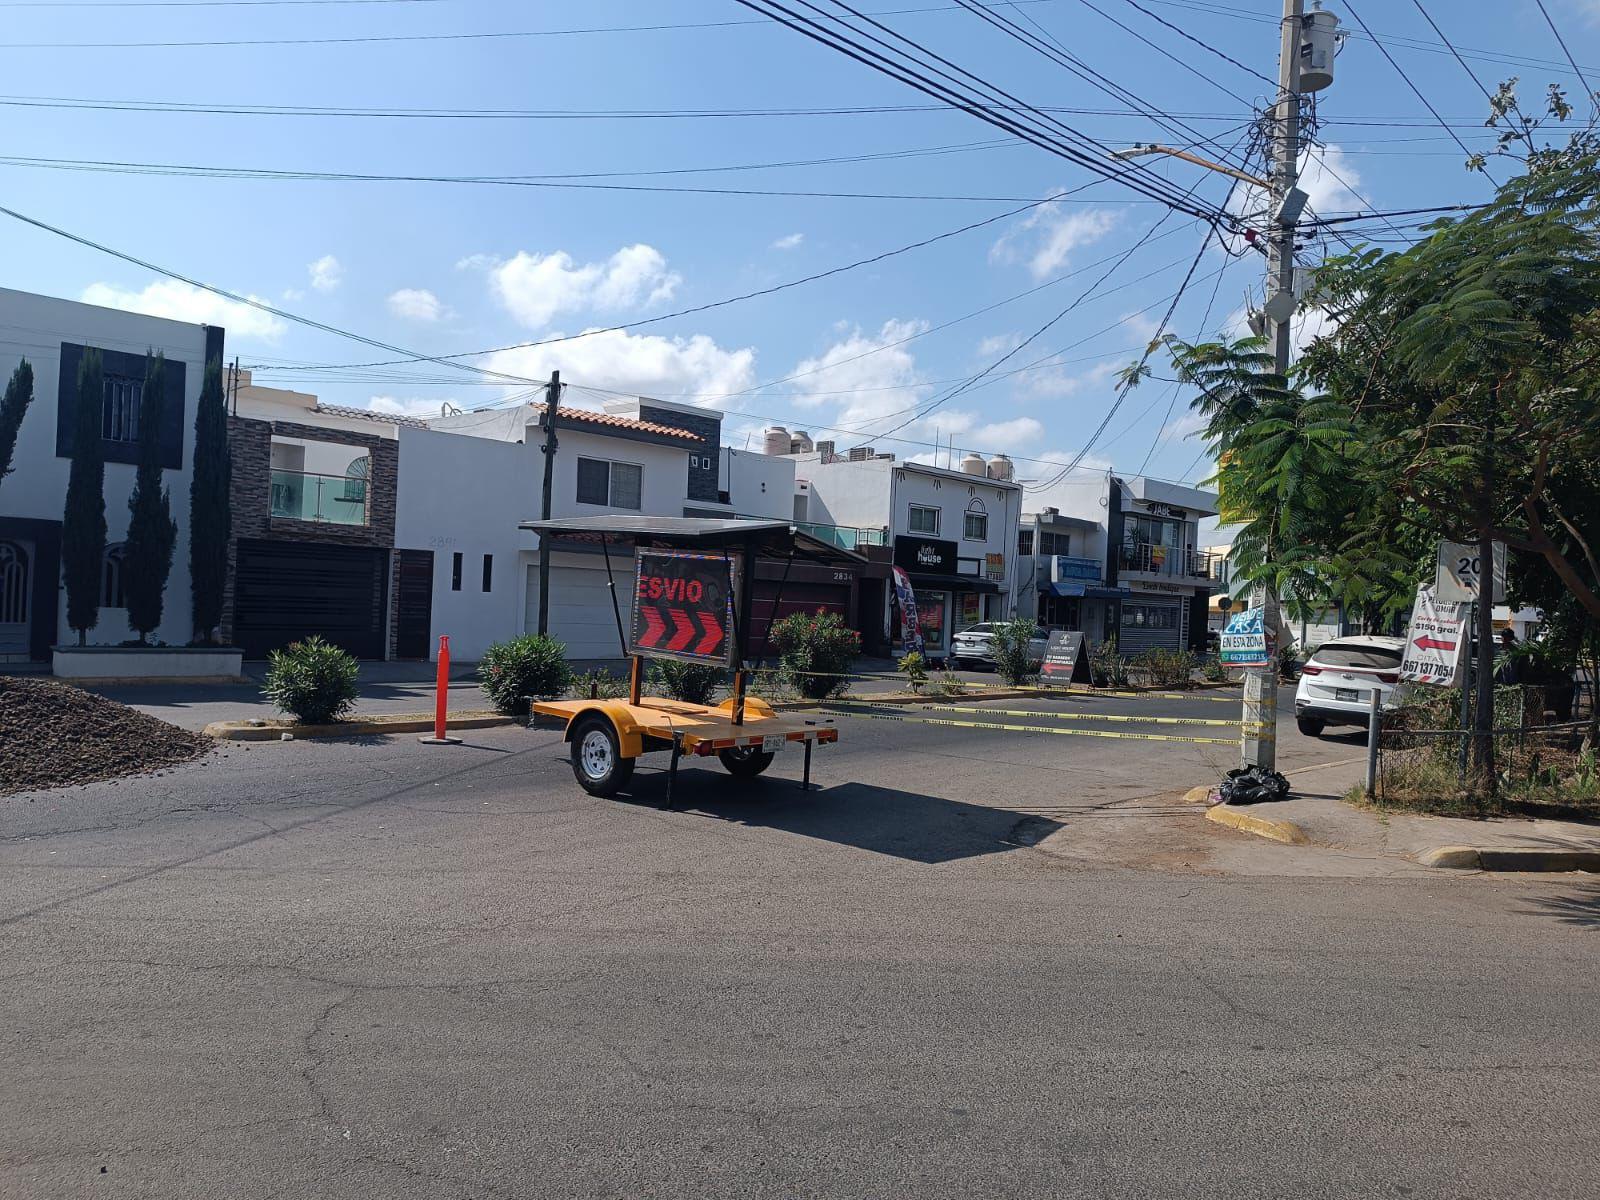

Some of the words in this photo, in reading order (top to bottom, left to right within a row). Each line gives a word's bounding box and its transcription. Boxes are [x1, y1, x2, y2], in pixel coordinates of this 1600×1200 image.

[917, 550, 942, 564] house
[1225, 620, 1263, 634] CASA
[1415, 623, 1436, 631] $150
[1223, 636, 1232, 648] EN
[1247, 636, 1264, 648] ZONA
[1403, 660, 1419, 673] 667
[1420, 662, 1433, 675] 137
[1434, 664, 1454, 678] 7054
